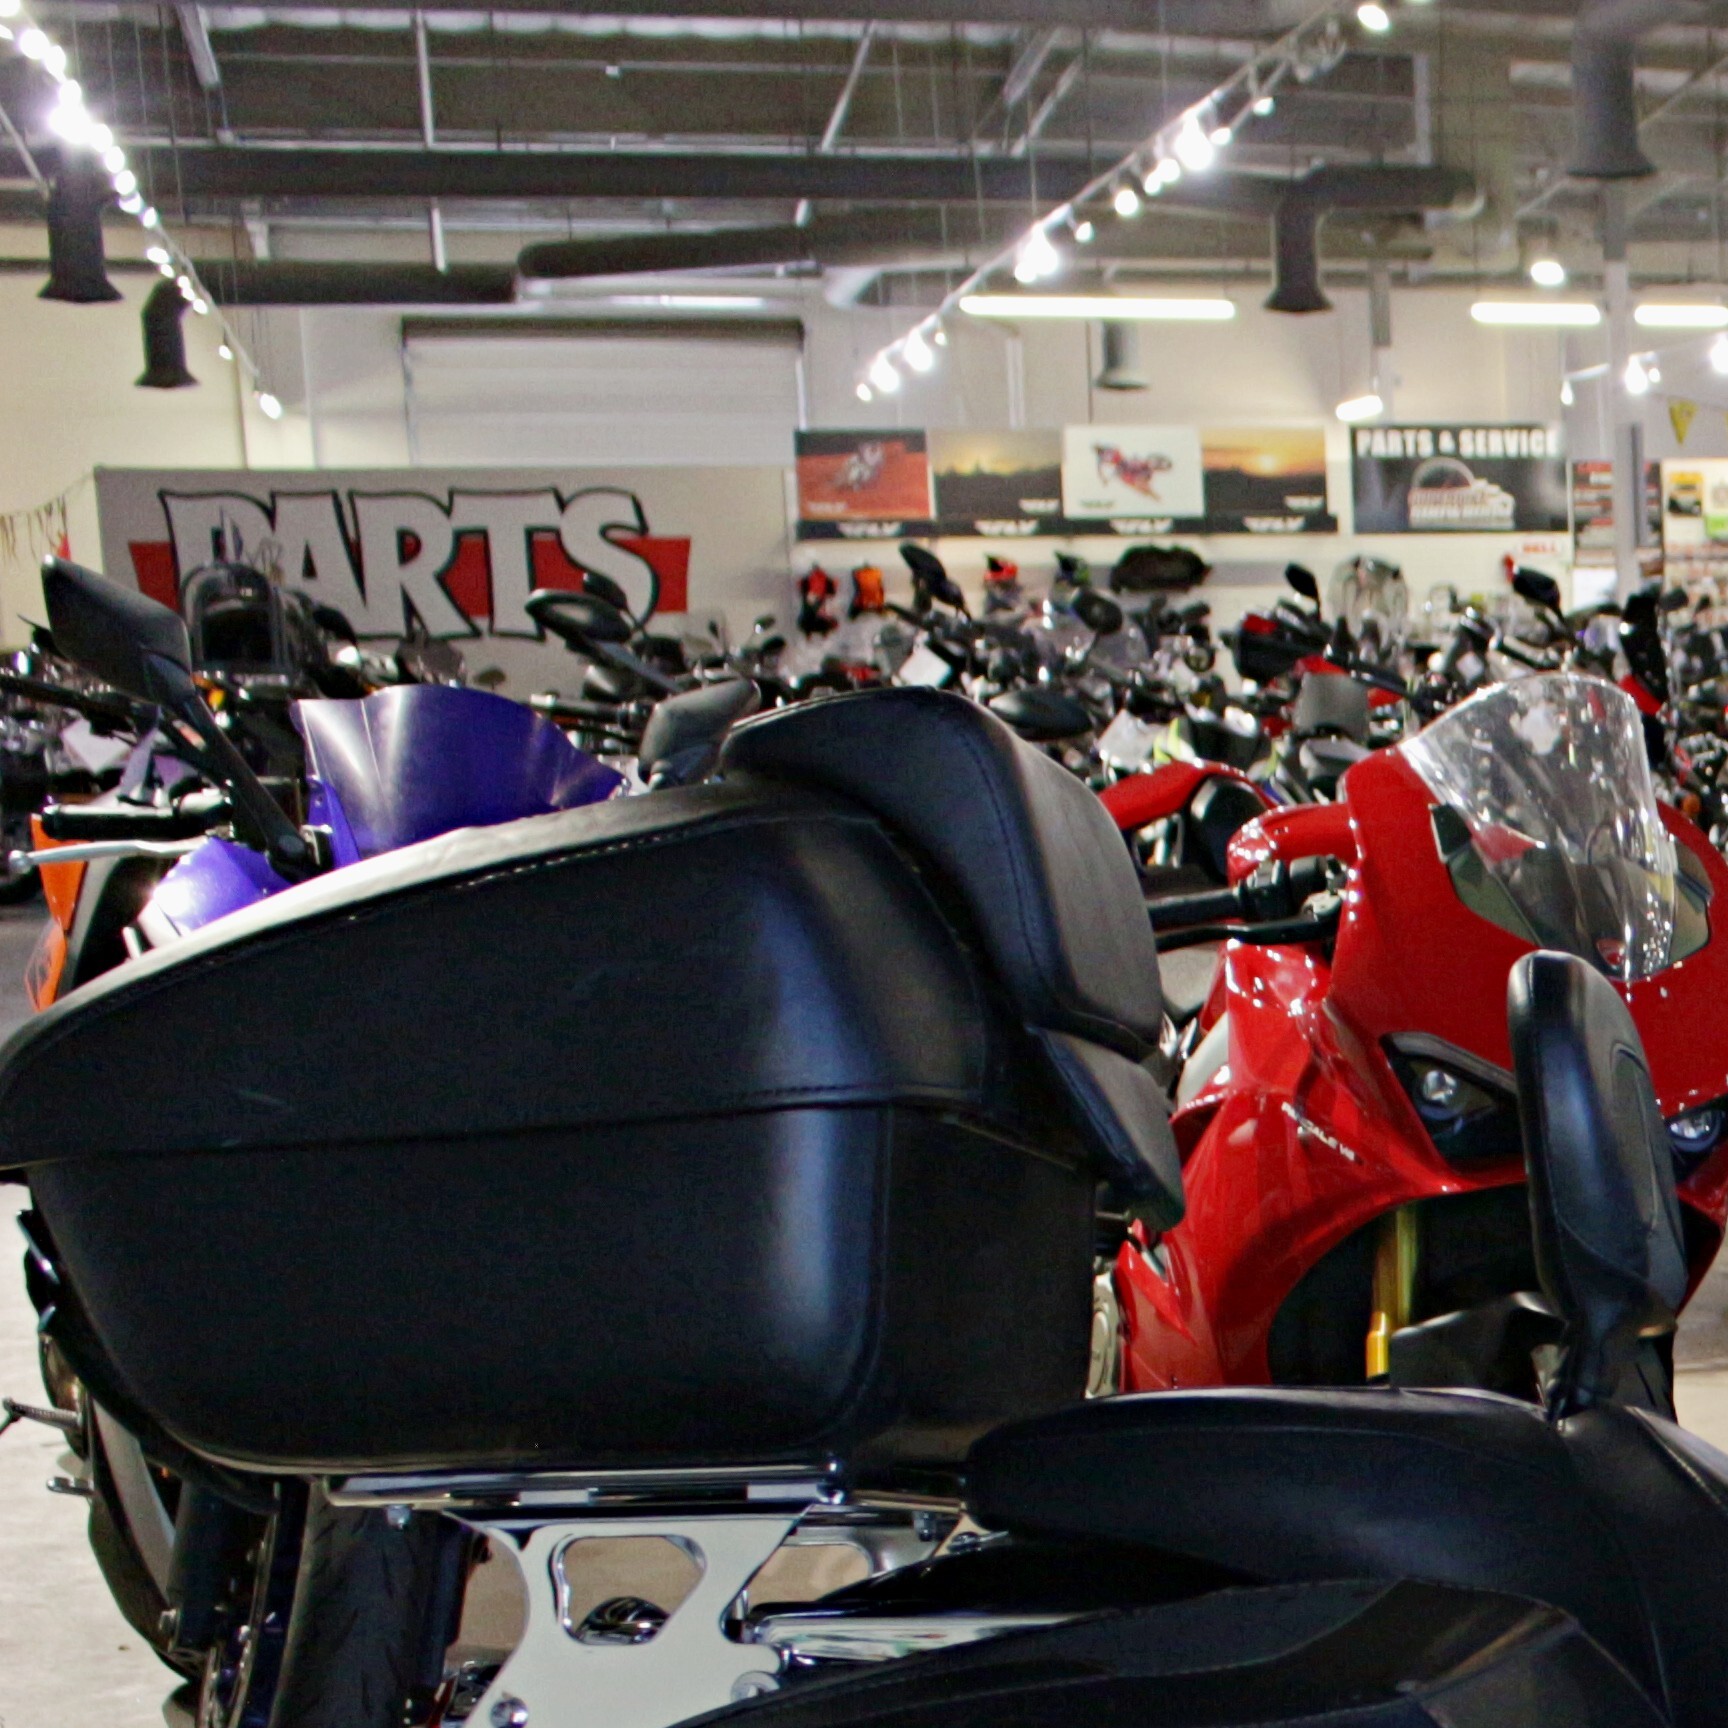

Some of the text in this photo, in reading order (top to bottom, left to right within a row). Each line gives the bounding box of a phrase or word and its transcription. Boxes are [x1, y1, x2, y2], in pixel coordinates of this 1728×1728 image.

[1356, 429, 1433, 457] PARTS
[1458, 429, 1560, 457] SERVICE
[157, 487, 660, 643] PARTS
